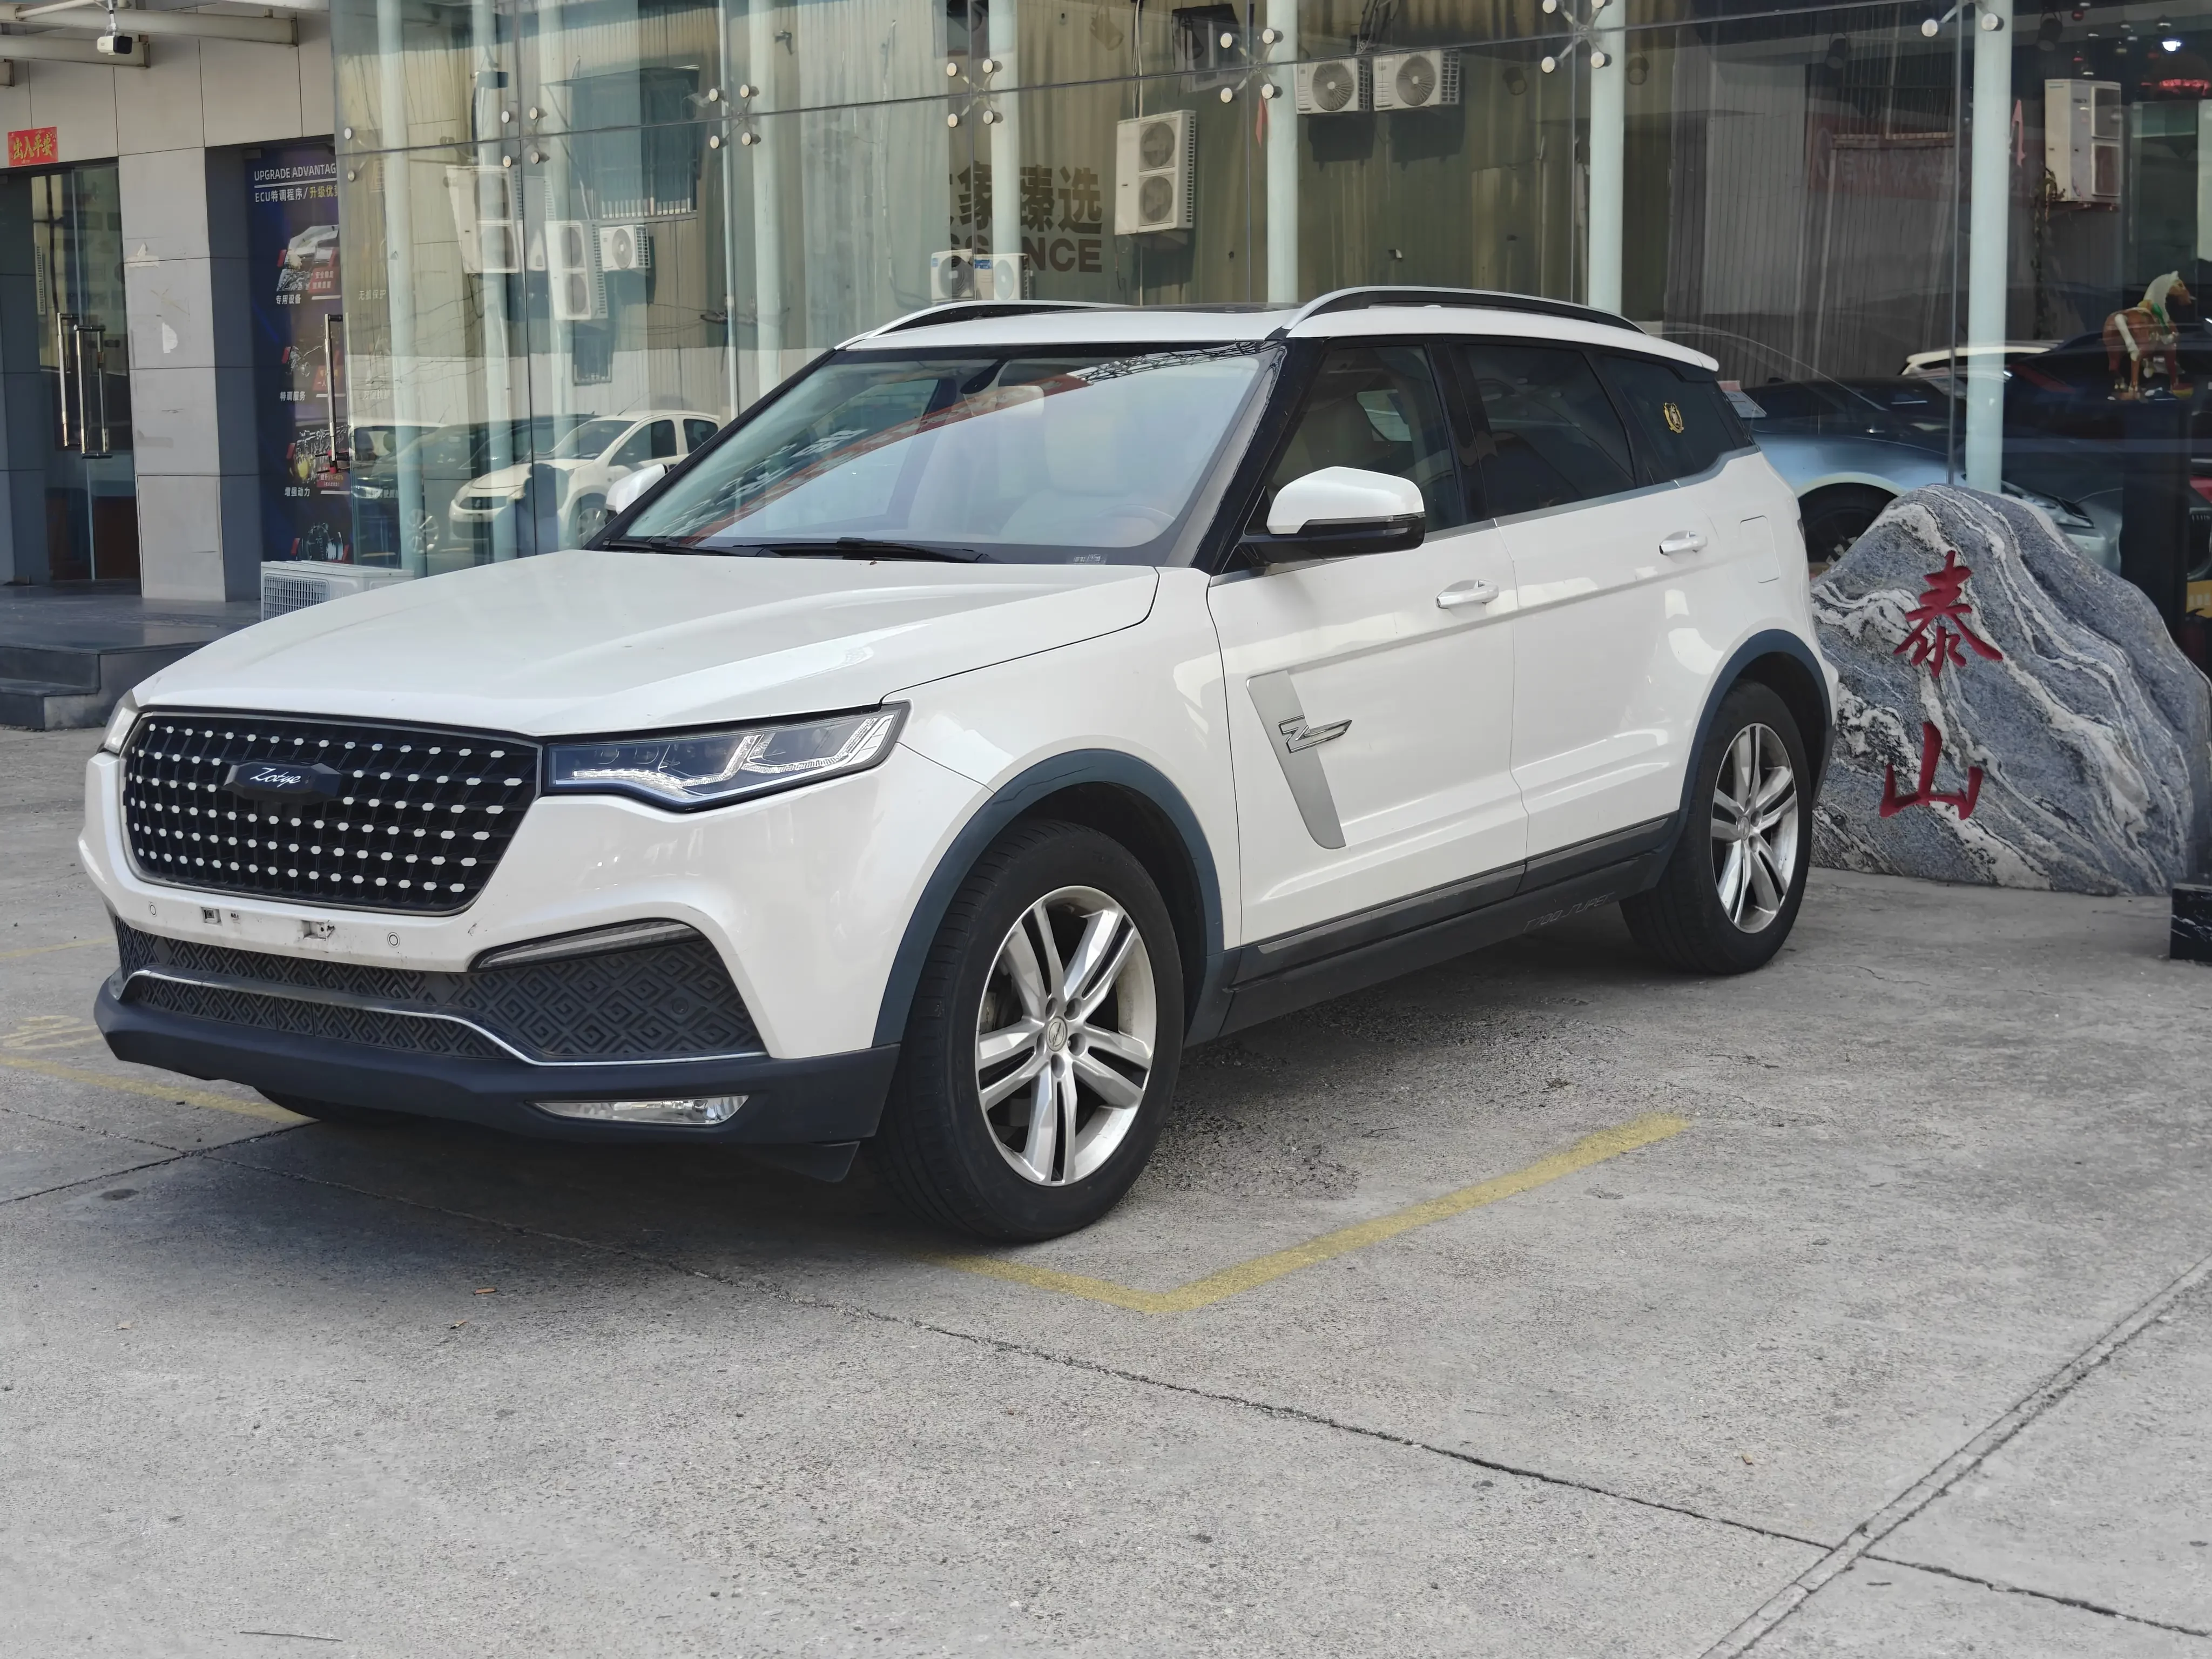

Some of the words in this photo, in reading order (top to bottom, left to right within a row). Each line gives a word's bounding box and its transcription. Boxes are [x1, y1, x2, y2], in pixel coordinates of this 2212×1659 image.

[14, 132, 52, 160] 出入平安
[254, 168, 291, 181] UPGRADE
[292, 163, 336, 178] ADVANTAG
[276, 294, 301, 304] 专用设备
[280, 391, 306, 401] 特调服务
[285, 487, 311, 497] 增强动力
[1879, 550, 2004, 821] 泰山
[249, 767, 301, 788] Zotye
